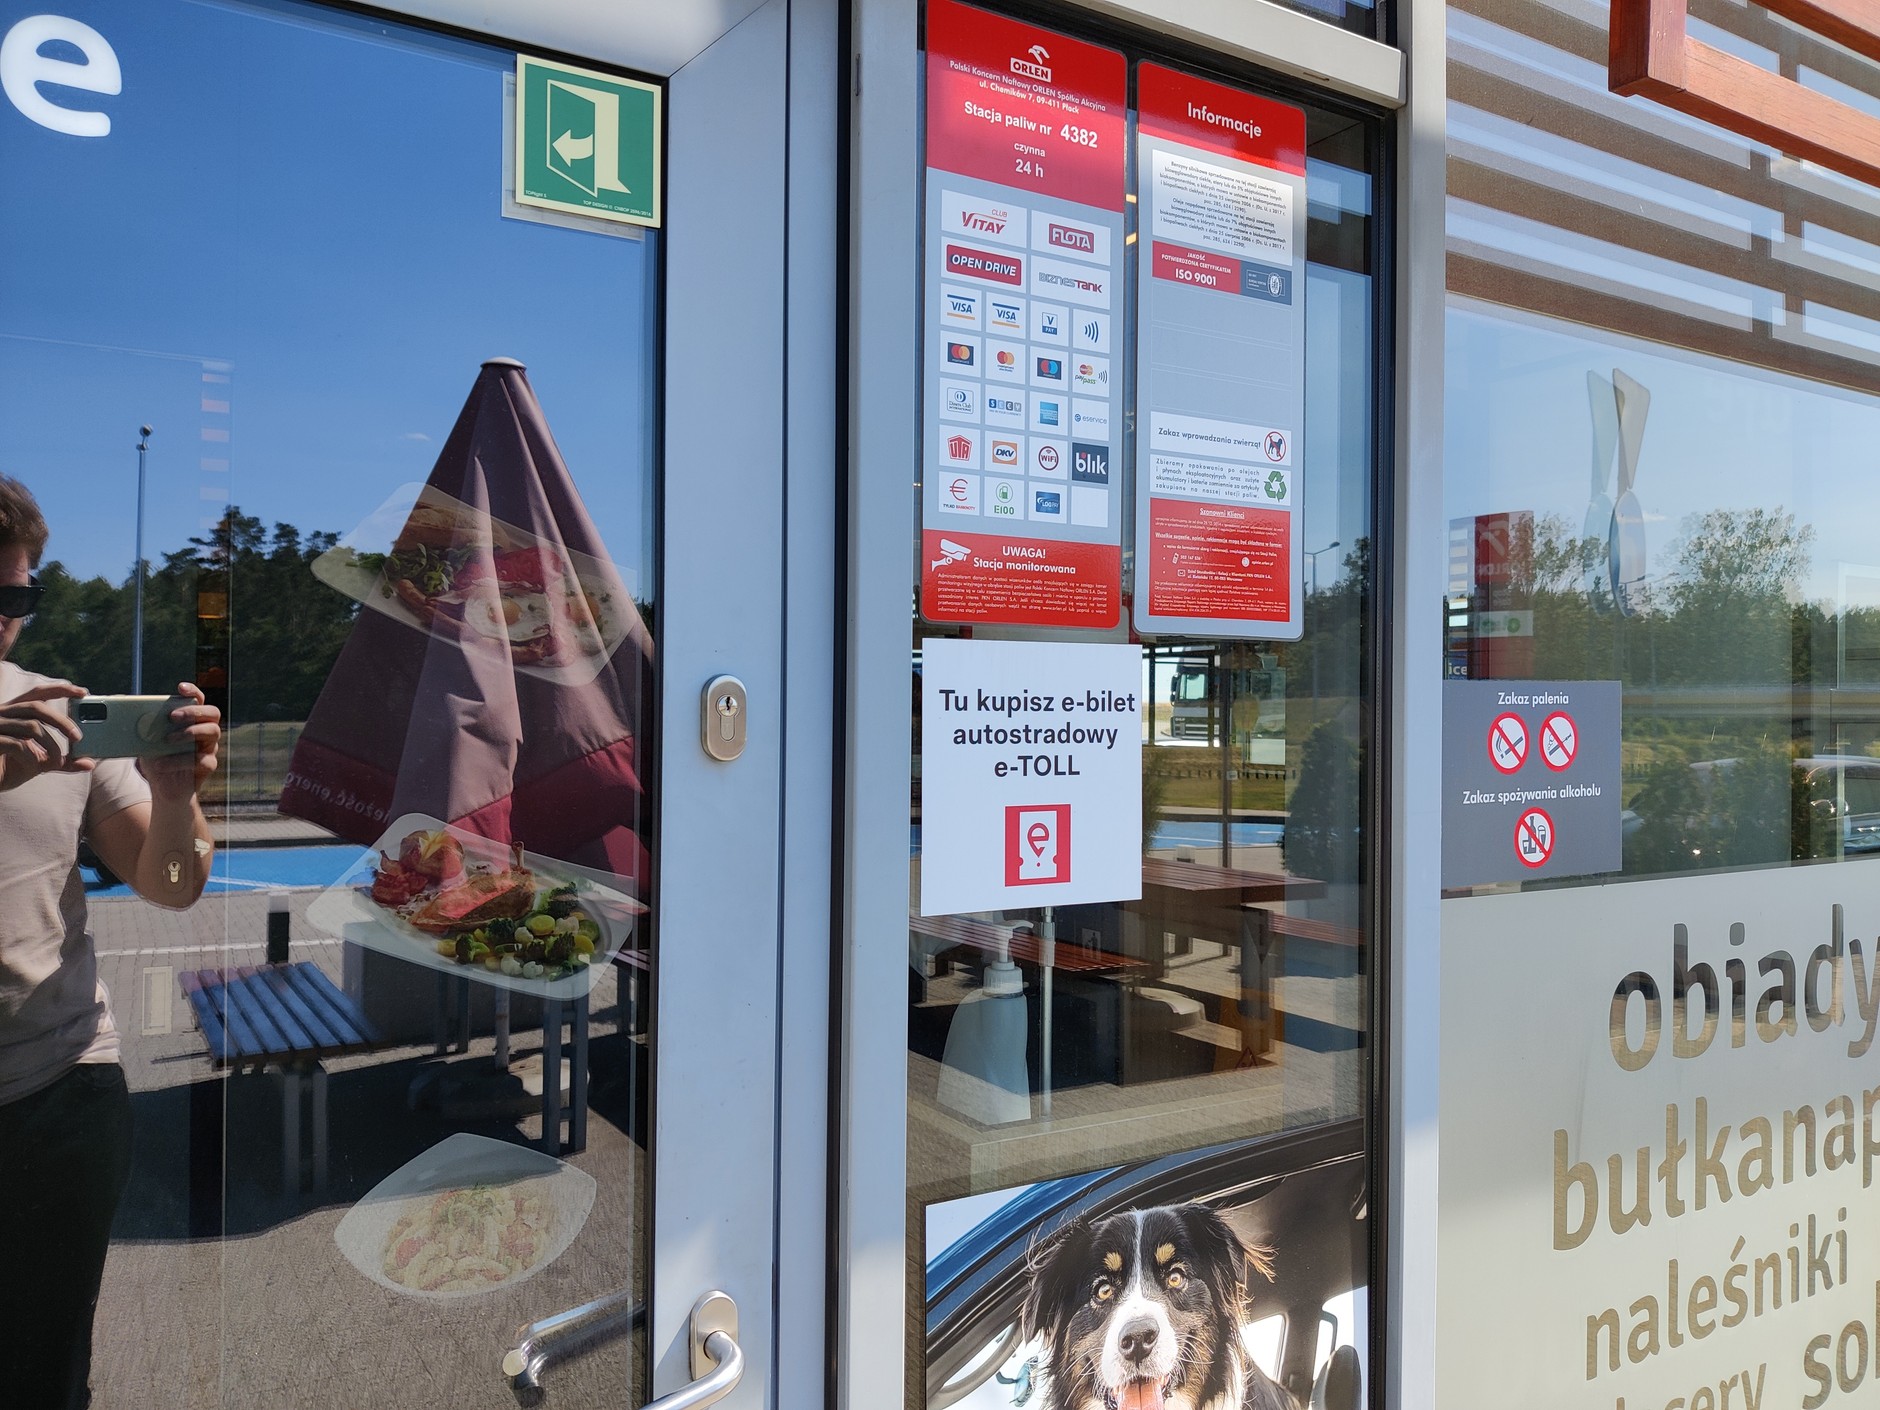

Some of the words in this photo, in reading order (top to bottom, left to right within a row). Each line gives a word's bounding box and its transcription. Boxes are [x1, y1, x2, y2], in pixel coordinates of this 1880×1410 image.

[1013, 62, 1049, 80] ORLEN
[950, 60, 971, 73] Polski
[972, 66, 1001, 81] Koncern
[1002, 75, 1031, 92] Naftowy
[1032, 84, 1056, 97] ORLEN
[1058, 91, 1080, 104] Spółka
[1081, 98, 1106, 112] Akcyjna
[979, 79, 988, 88] ul.
[990, 82, 1026, 99] Chemików
[1028, 92, 1035, 103] 7,
[1036, 94, 1059, 108] 09-411
[1062, 101, 1080, 114] Płock
[964, 101, 1001, 122] Stacja
[1005, 115, 1036, 131] paliw
[1040, 124, 1052, 135] nr
[1060, 124, 1098, 148] 4382
[1187, 101, 1262, 139] Informacje
[1014, 142, 1046, 157] czynna
[1015, 159, 1032, 174] 24
[1036, 162, 1044, 177] h
[962, 211, 1006, 234] VITAY
[991, 208, 1007, 218] CLUB
[1052, 227, 1091, 249] FLOTA
[951, 254, 982, 270] OPEN
[985, 259, 1017, 277] DRIVE
[1175, 268, 1193, 280] ISO
[1194, 272, 1217, 286] 9001
[950, 301, 973, 314] VISA
[996, 308, 1016, 321] VISA
[1158, 428, 1180, 438] Zakaz
[1182, 432, 1231, 444] wprowadzania
[1233, 438, 1261, 449] zwierząt
[996, 449, 1014, 458] DKV
[1075, 452, 1107, 475] blik
[1002, 546, 1046, 559] UWAGA!
[973, 557, 1004, 571] Stacja
[1006, 562, 1076, 574] monitorowana
[939, 689, 968, 712] Tu
[977, 688, 1054, 718] kupisz
[1061, 689, 1135, 712] e-bilet
[1497, 692, 1530, 705] Zakaz
[1532, 691, 1569, 708] palenia
[953, 722, 1118, 750] autostradowy
[994, 754, 1080, 777] e-TOLL
[1462, 790, 1495, 805] Zakaz
[1497, 785, 1557, 805] spożywania
[1559, 783, 1601, 799] alkoholu
[1609, 903, 1880, 1072] obiady
[1585, 1206, 1848, 1381] naleśniki
